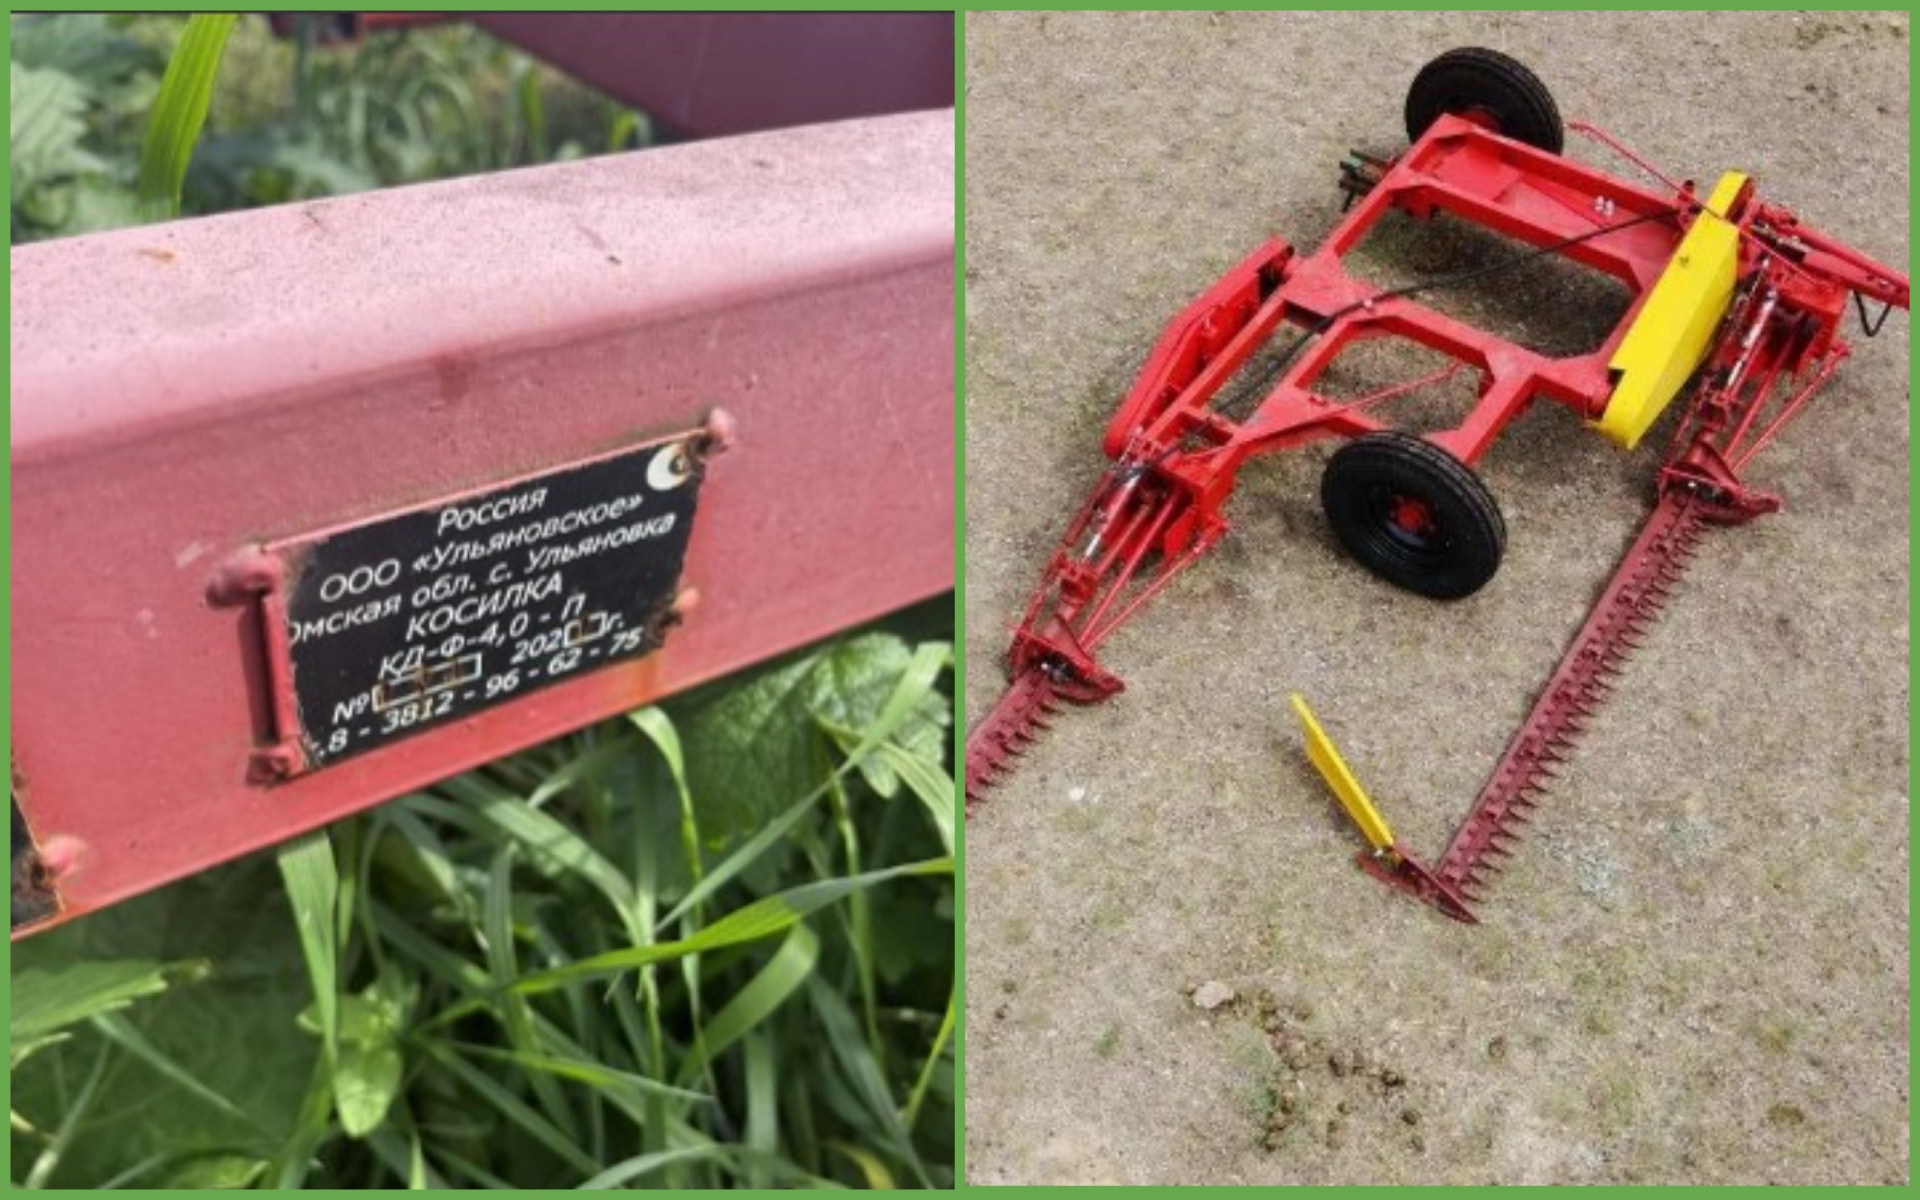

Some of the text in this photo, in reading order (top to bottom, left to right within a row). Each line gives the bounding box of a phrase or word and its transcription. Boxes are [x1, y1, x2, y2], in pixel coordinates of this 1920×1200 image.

[320, 493, 643, 602] ООО «Ульяновское»
[411, 574, 477, 608] обл.
[524, 511, 677, 574] Ульяновка
[405, 570, 563, 642] КОСИЛКА
